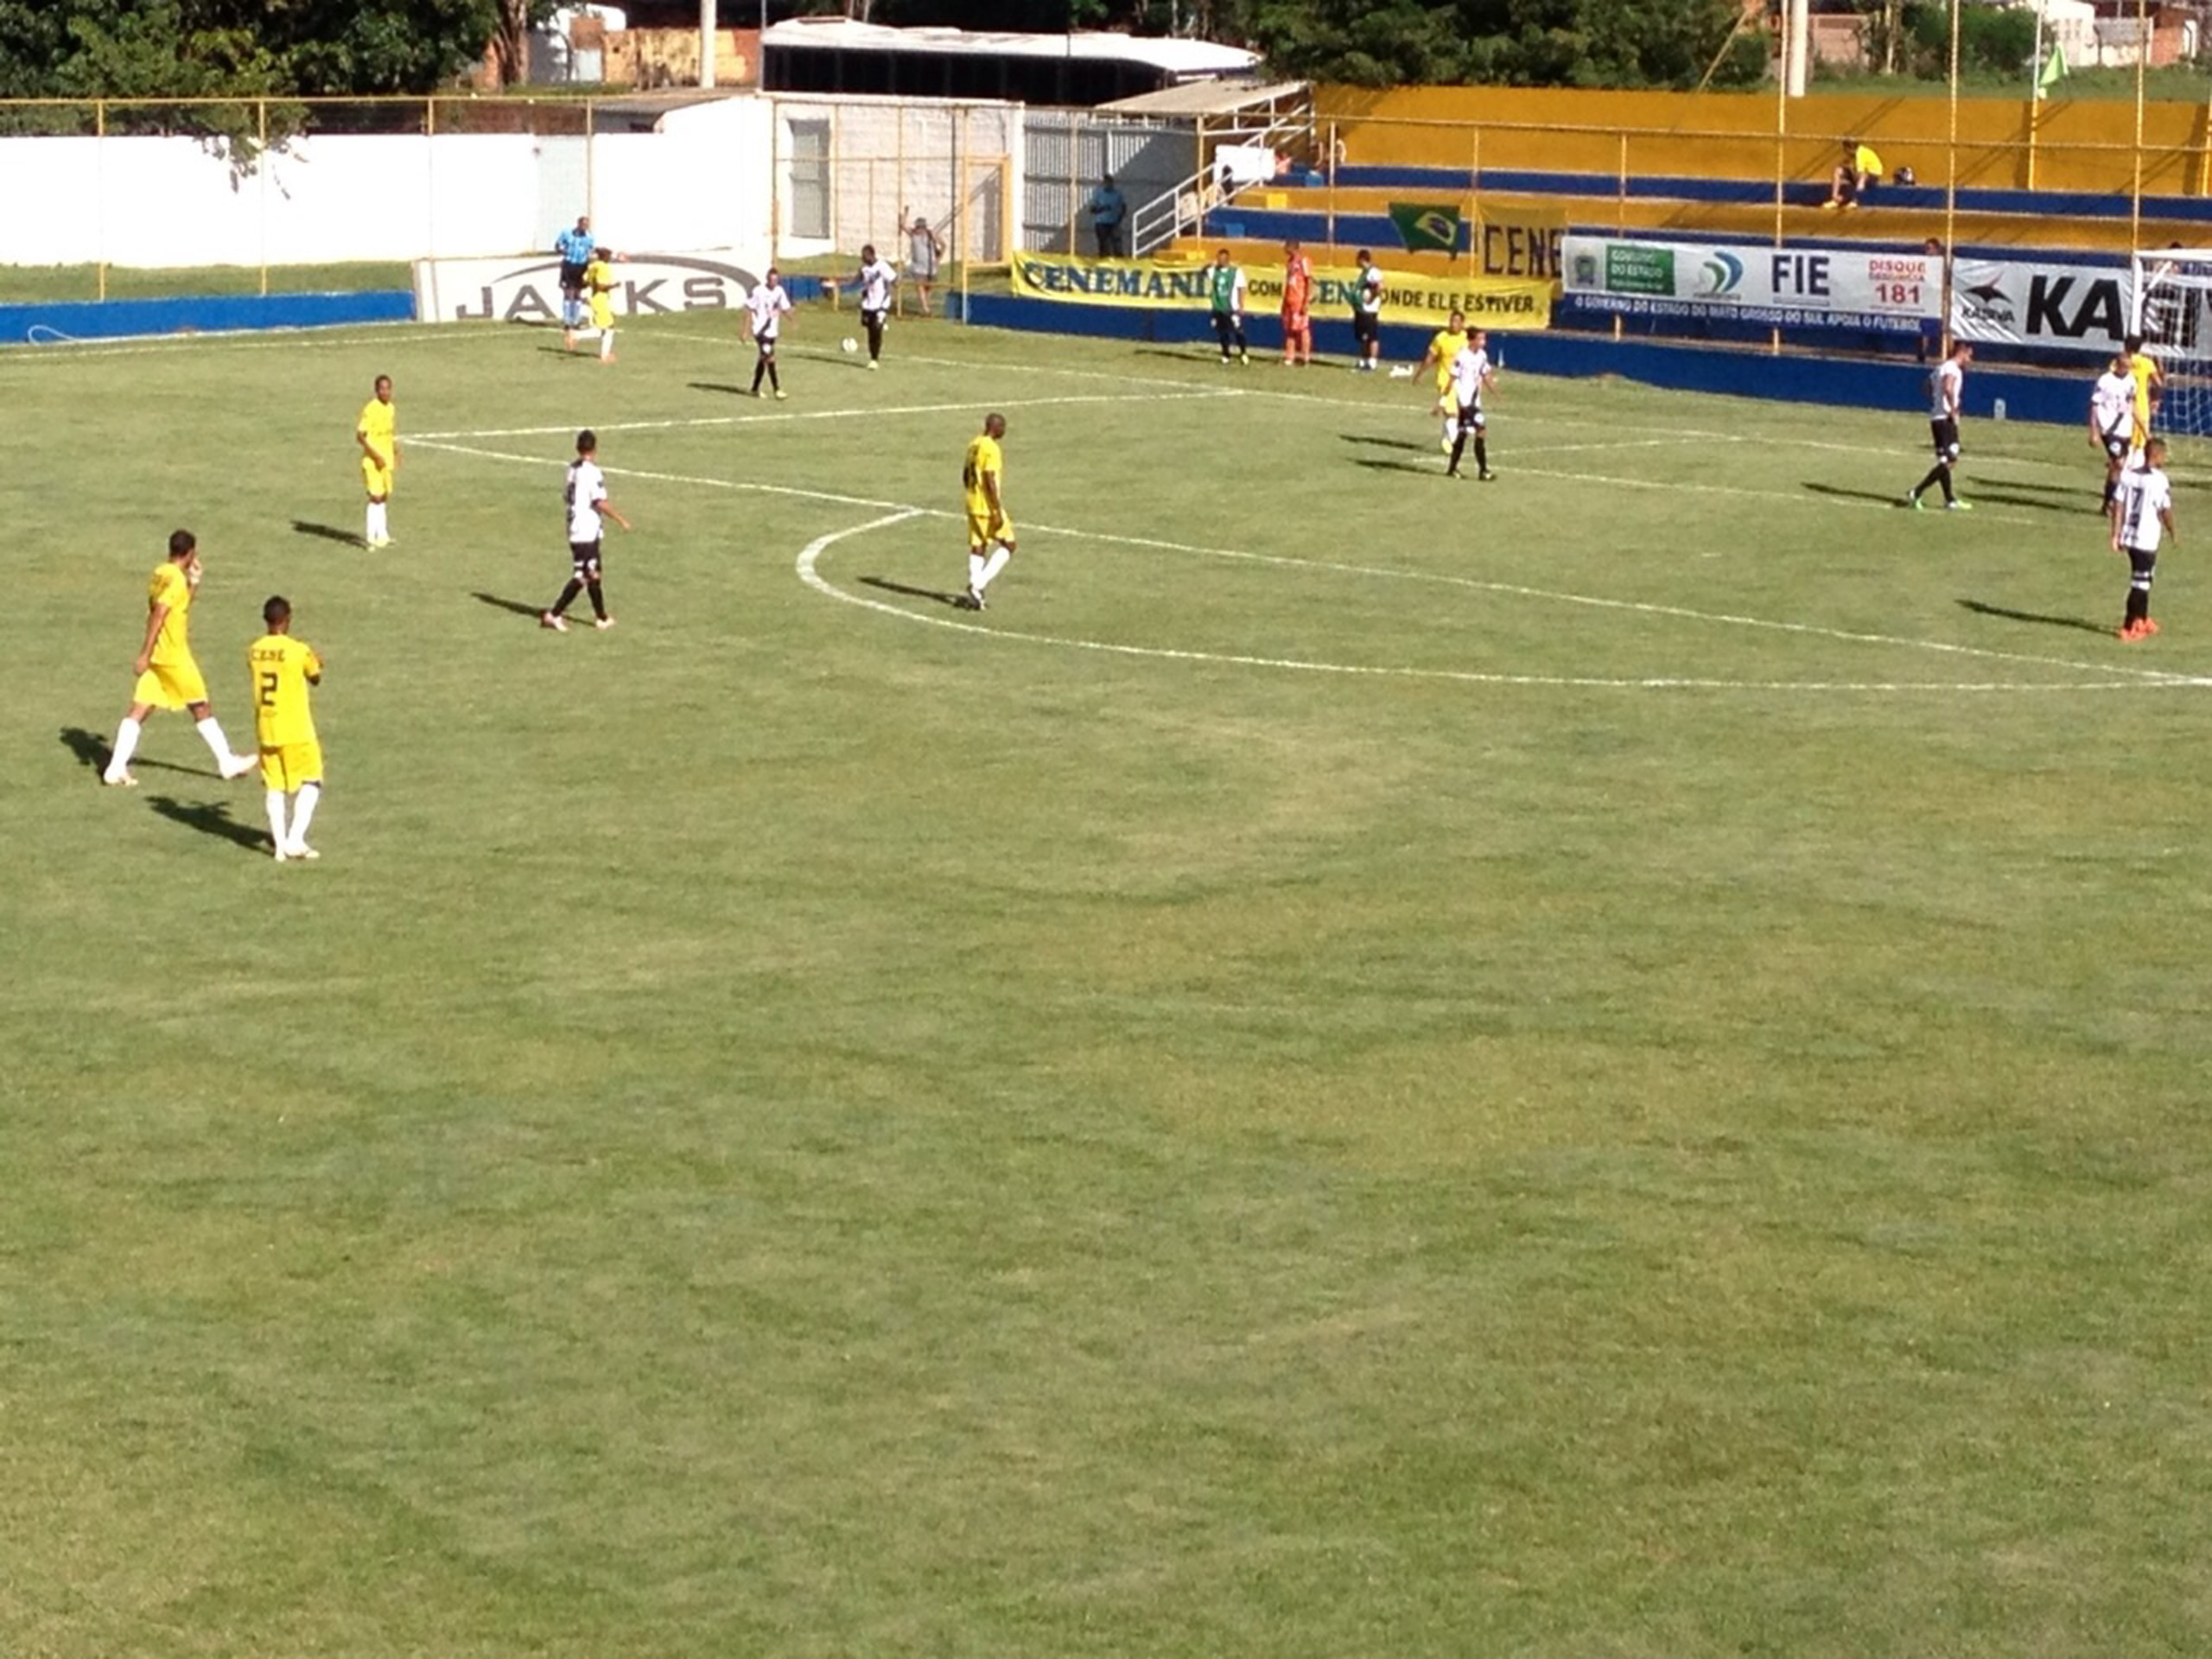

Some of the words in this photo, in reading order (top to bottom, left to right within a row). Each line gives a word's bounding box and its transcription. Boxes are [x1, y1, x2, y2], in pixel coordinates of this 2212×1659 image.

[1773, 255, 1830, 296] FIE
[1869, 260, 1926, 274] DISQUE
[456, 276, 727, 320] JAKS
[1025, 262, 1213, 297] CENEMANI
[1248, 280, 1283, 296] COM
[1428, 292, 1459, 311] ELE
[1464, 294, 1534, 313] ESTIVER
[1875, 283, 1920, 304] 181
[260, 671, 278, 707] 2
